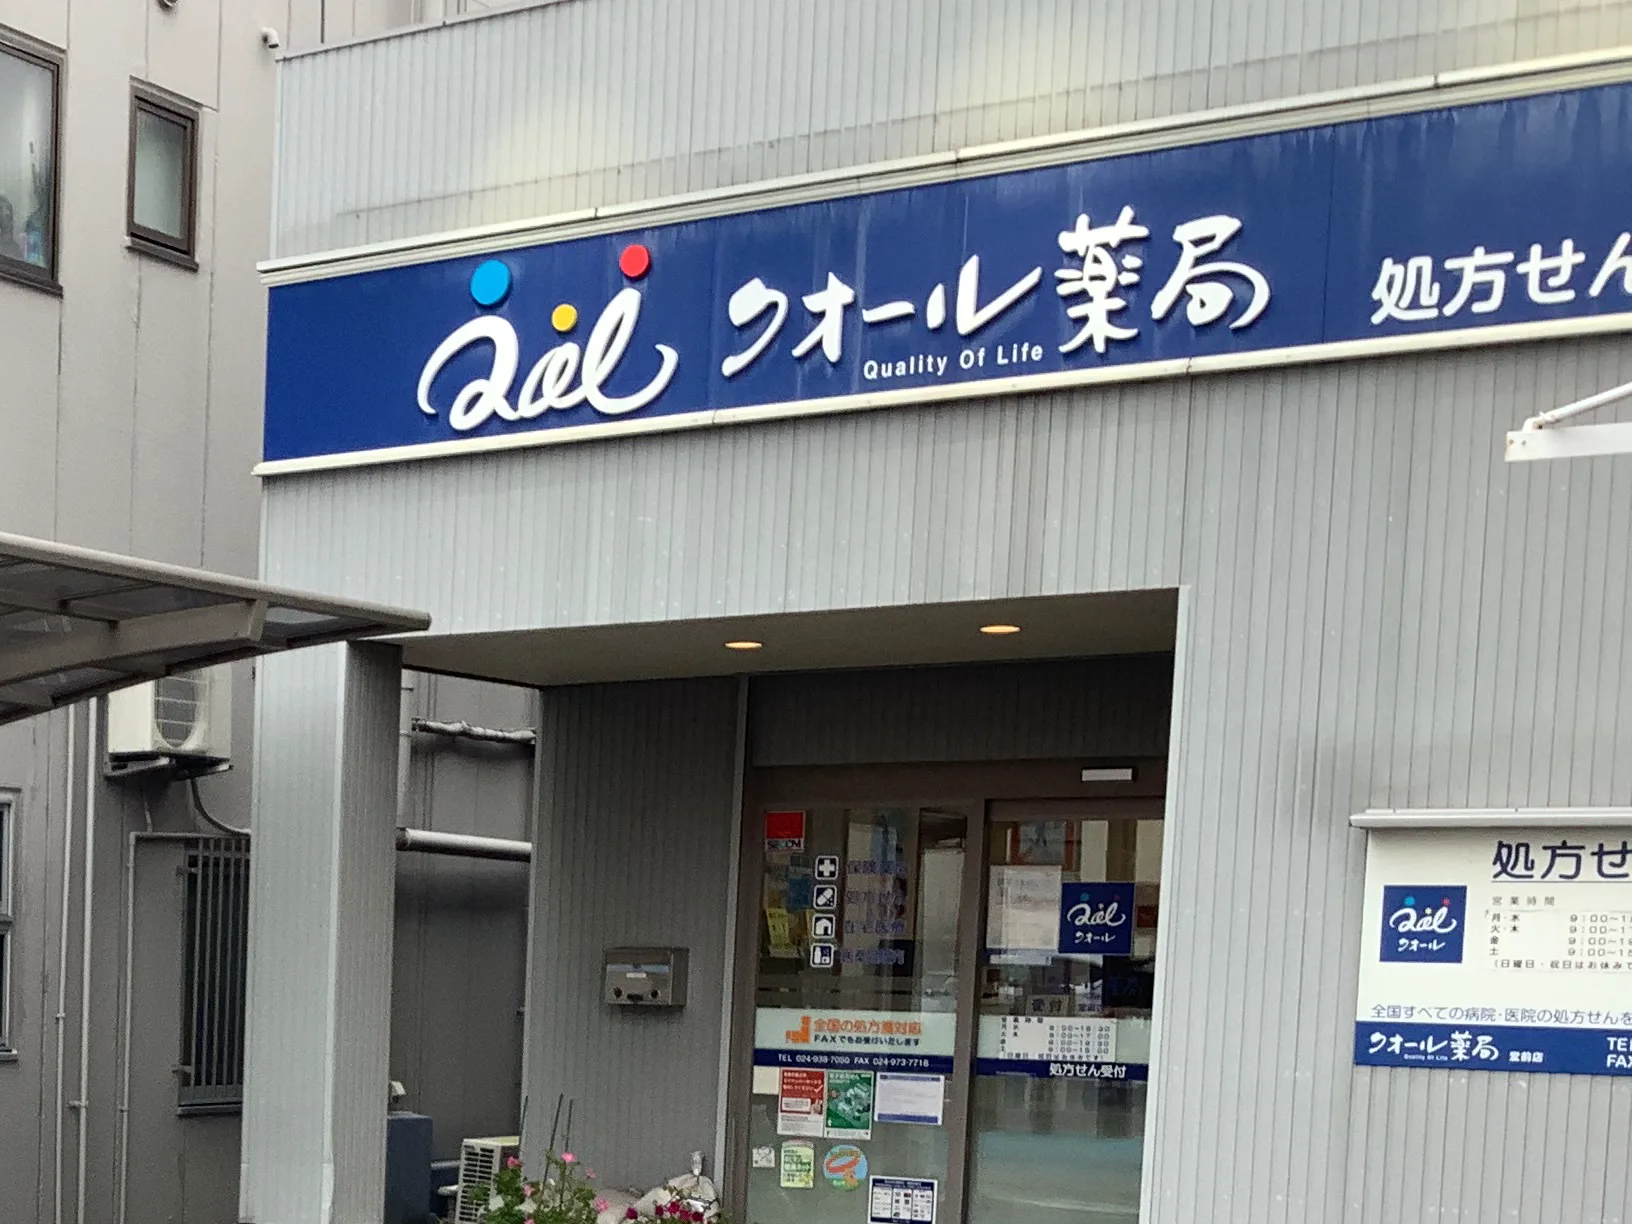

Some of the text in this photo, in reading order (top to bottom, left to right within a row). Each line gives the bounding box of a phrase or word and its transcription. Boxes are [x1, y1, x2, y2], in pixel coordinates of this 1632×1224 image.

[721, 205, 1270, 378] クオール薬局
[862, 342, 1044, 381] Quality Of Life
[1492, 896, 1555, 906] 営業時間
[1074, 931, 1116, 944] クオール
[1397, 937, 1445, 952] クオール
[1369, 1030, 1499, 1061] クオール薬局
[778, 1053, 793, 1063] TEL
[854, 1056, 869, 1065] FAX
[1049, 1063, 1128, 1078] 処方せん受付
